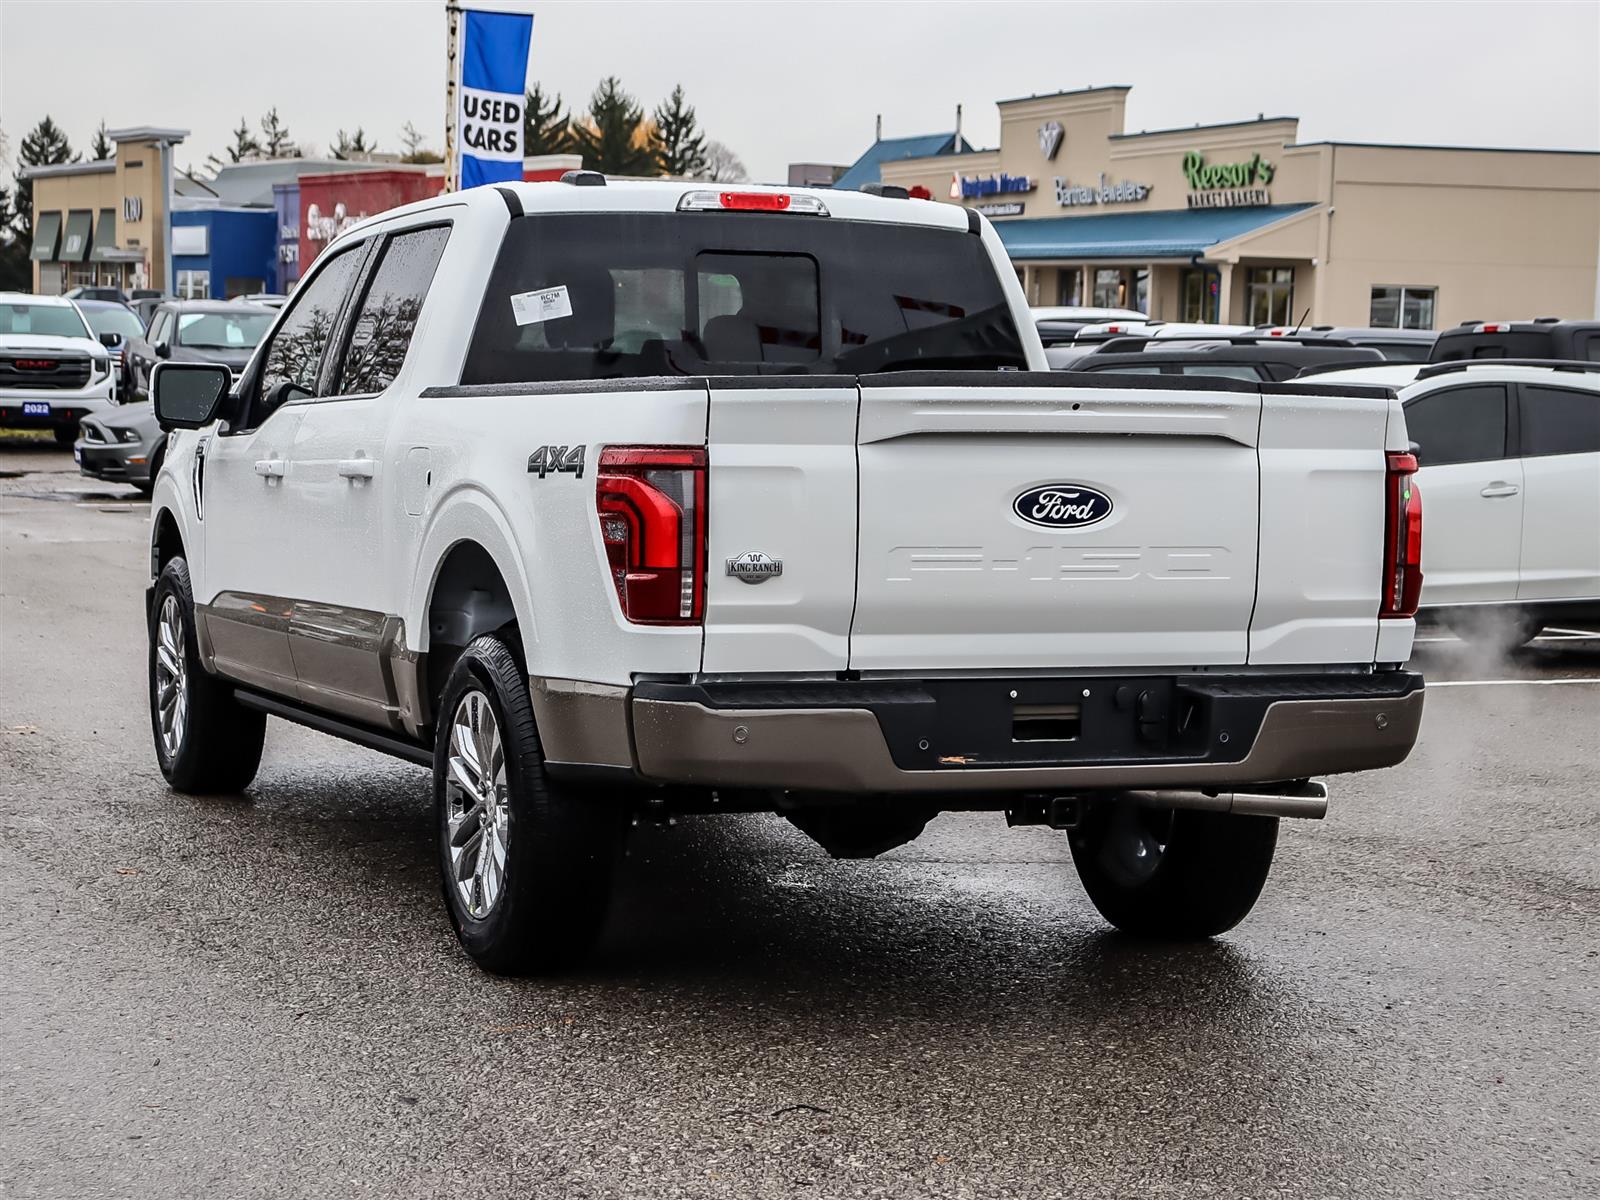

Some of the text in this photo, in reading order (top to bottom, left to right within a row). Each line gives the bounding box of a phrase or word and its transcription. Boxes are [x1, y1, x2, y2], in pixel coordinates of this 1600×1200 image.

[463, 95, 520, 124] USED
[463, 124, 518, 153] CARS
[1183, 151, 1271, 191] Reesor's
[24, 403, 49, 414] 2022
[1032, 490, 1096, 520] Ford
[730, 562, 780, 573] KING RANCH
[887, 546, 1233, 582] F-150
